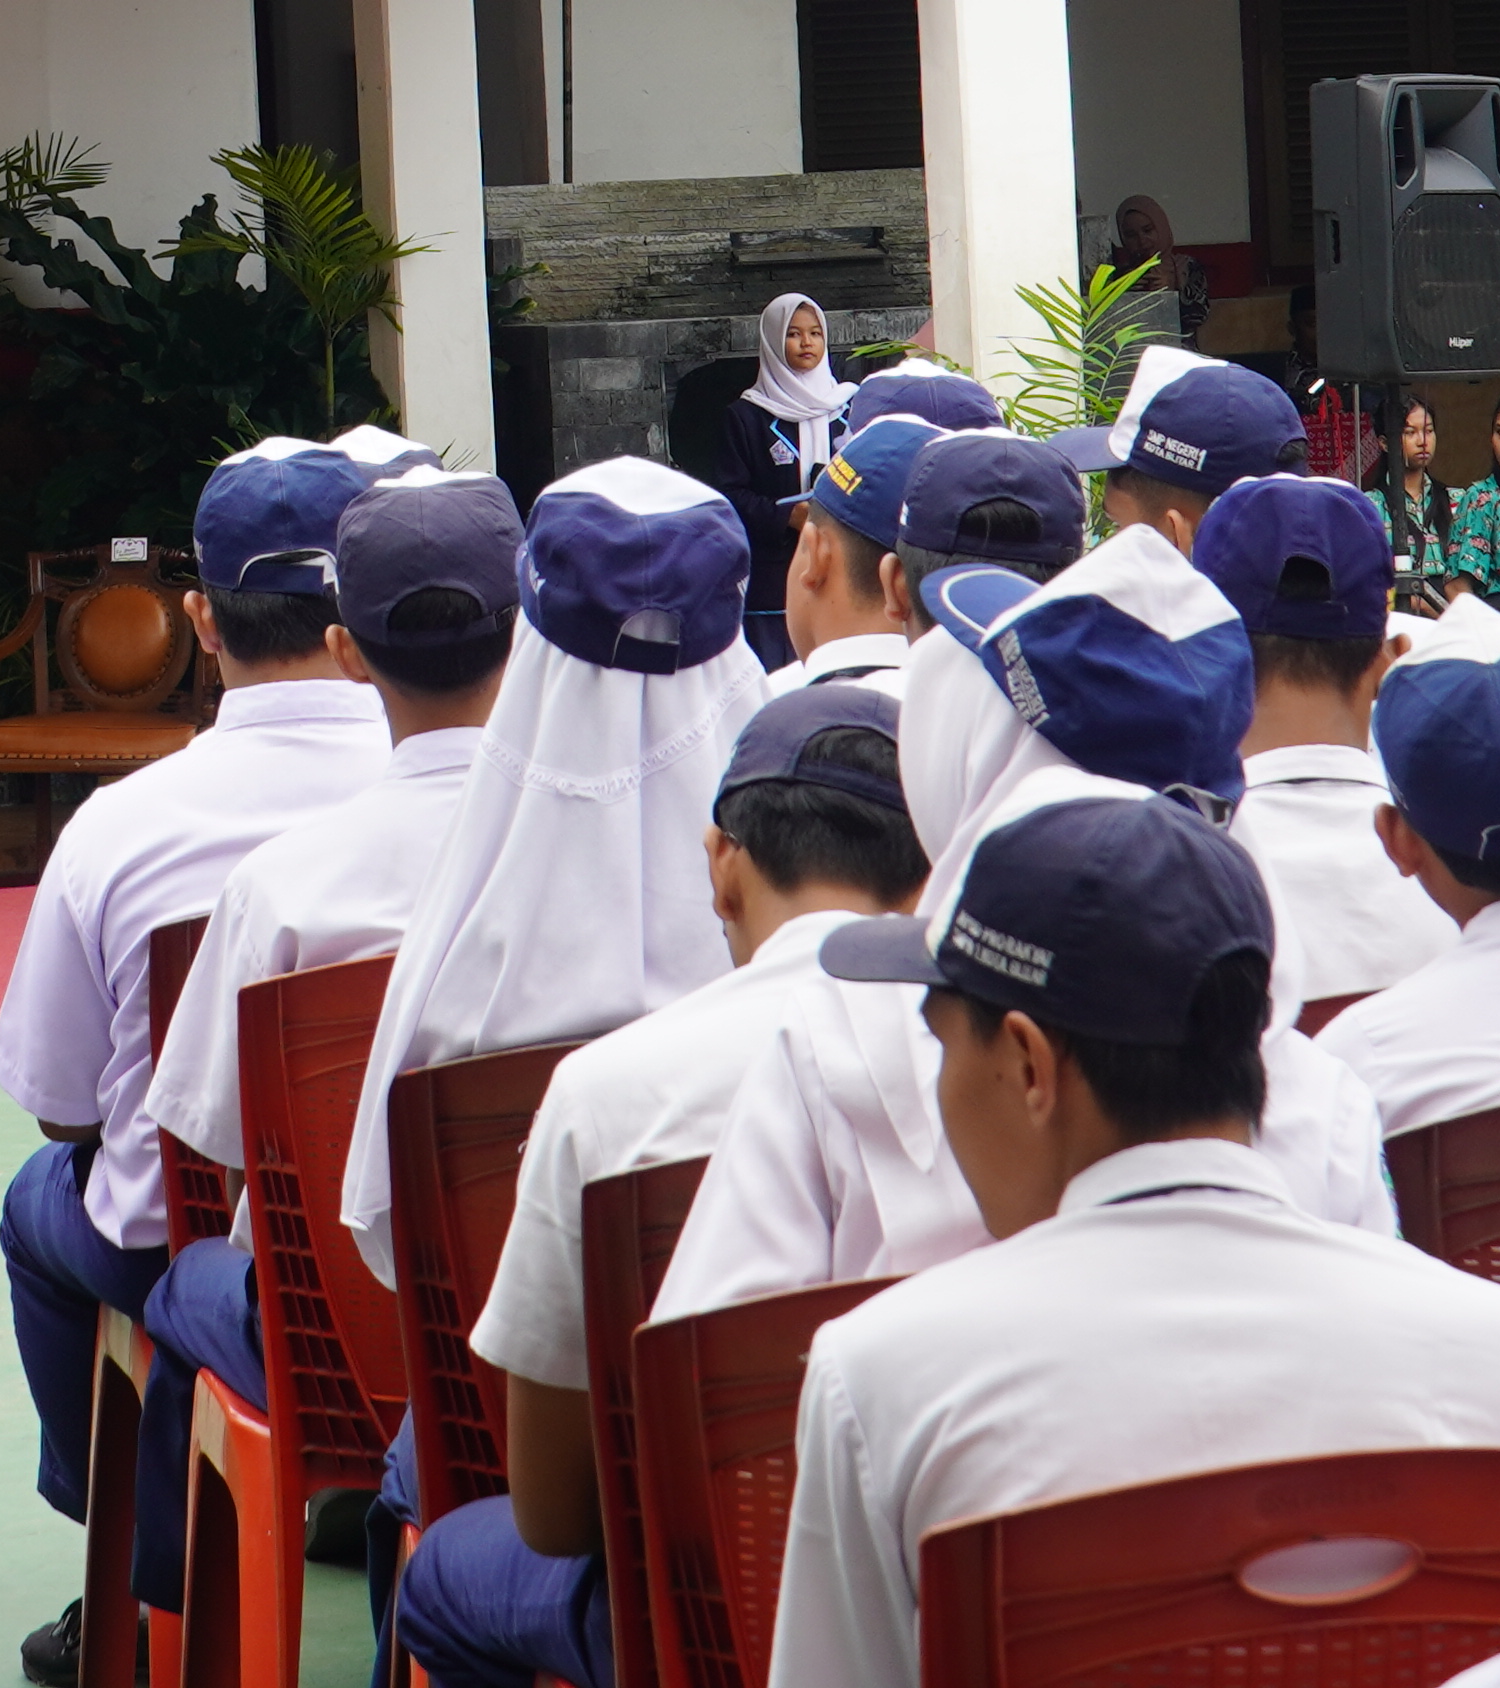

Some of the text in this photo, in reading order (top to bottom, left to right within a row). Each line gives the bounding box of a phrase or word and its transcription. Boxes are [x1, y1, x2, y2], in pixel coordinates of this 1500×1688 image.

[1147, 428, 1208, 472] SMP NEGERI 1
